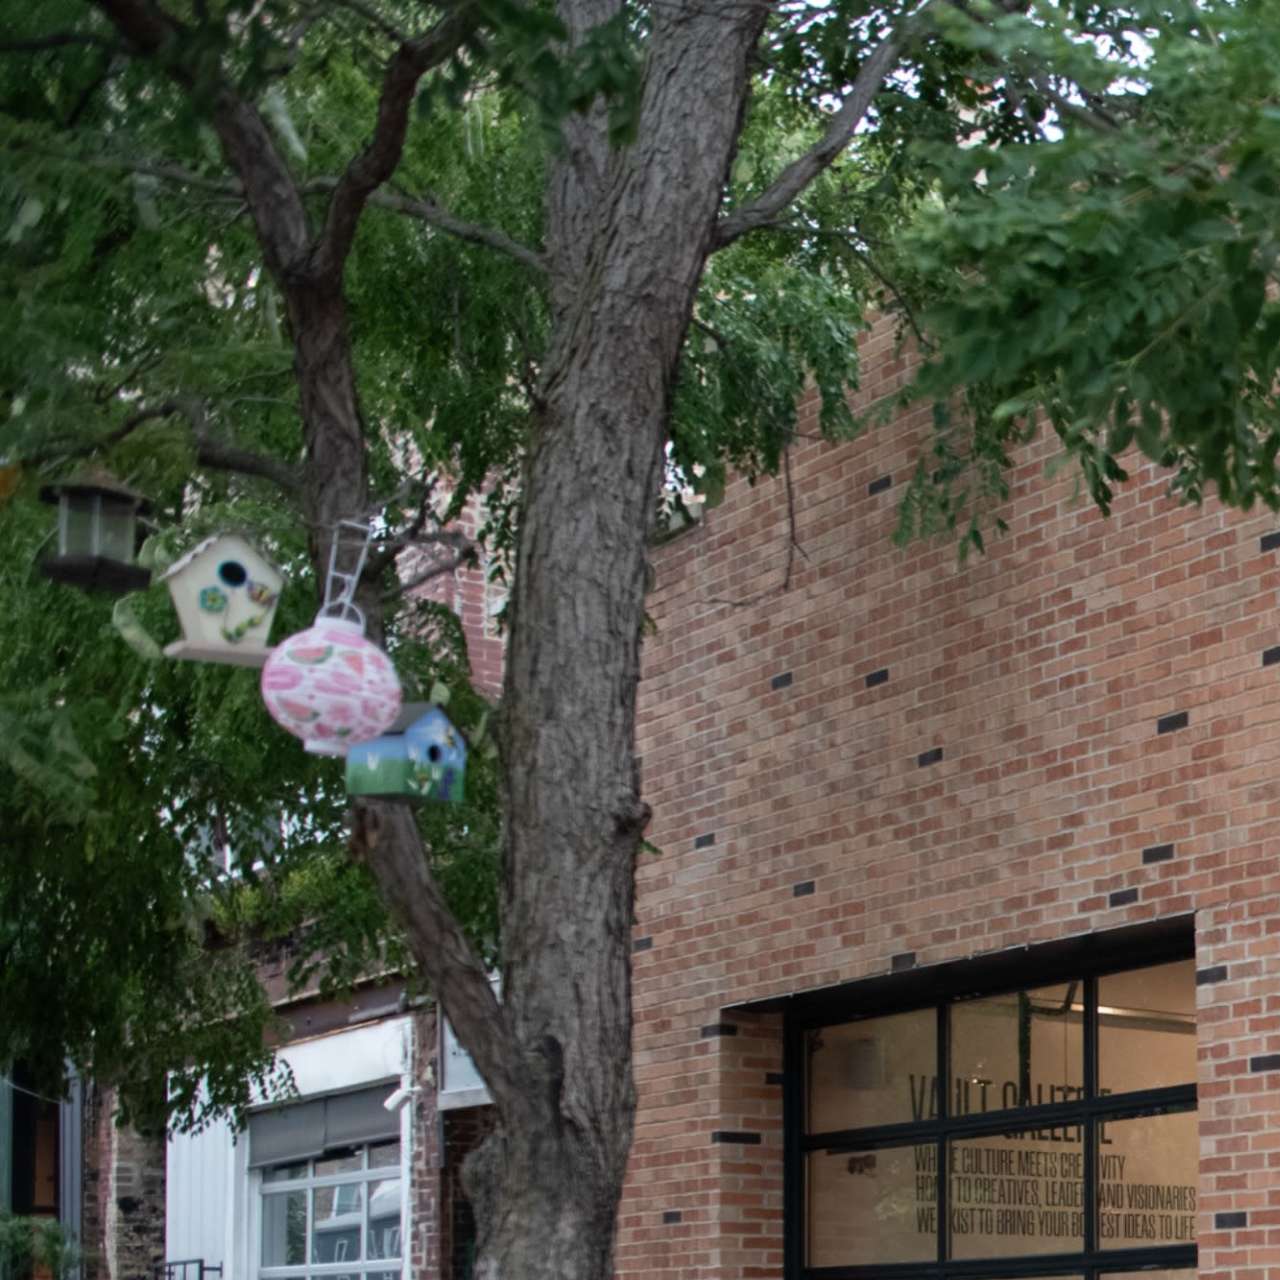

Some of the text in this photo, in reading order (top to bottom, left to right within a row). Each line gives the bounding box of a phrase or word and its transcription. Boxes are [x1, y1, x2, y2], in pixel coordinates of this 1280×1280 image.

[914, 1145, 1126, 1179] WHE CULTURE MEETS CREVITY
[955, 1176, 971, 1203] TO
[974, 1177, 1042, 1207] CREATIVES,
[1045, 1180, 1089, 1208] LEADE
[1099, 1182, 1123, 1209] AND
[1127, 1183, 1196, 1212] VISIONARIES
[917, 1206, 937, 1234] WE
[977, 1208, 993, 1235] TO
[997, 1209, 1035, 1236] BRING
[1037, 1210, 1069, 1237] YOUR
[1072, 1212, 1121, 1239] BOEST
[1124, 1213, 1156, 1239] IDEAS
[1159, 1214, 1173, 1240] TO
[1175, 1214, 1196, 1240] LIFE
